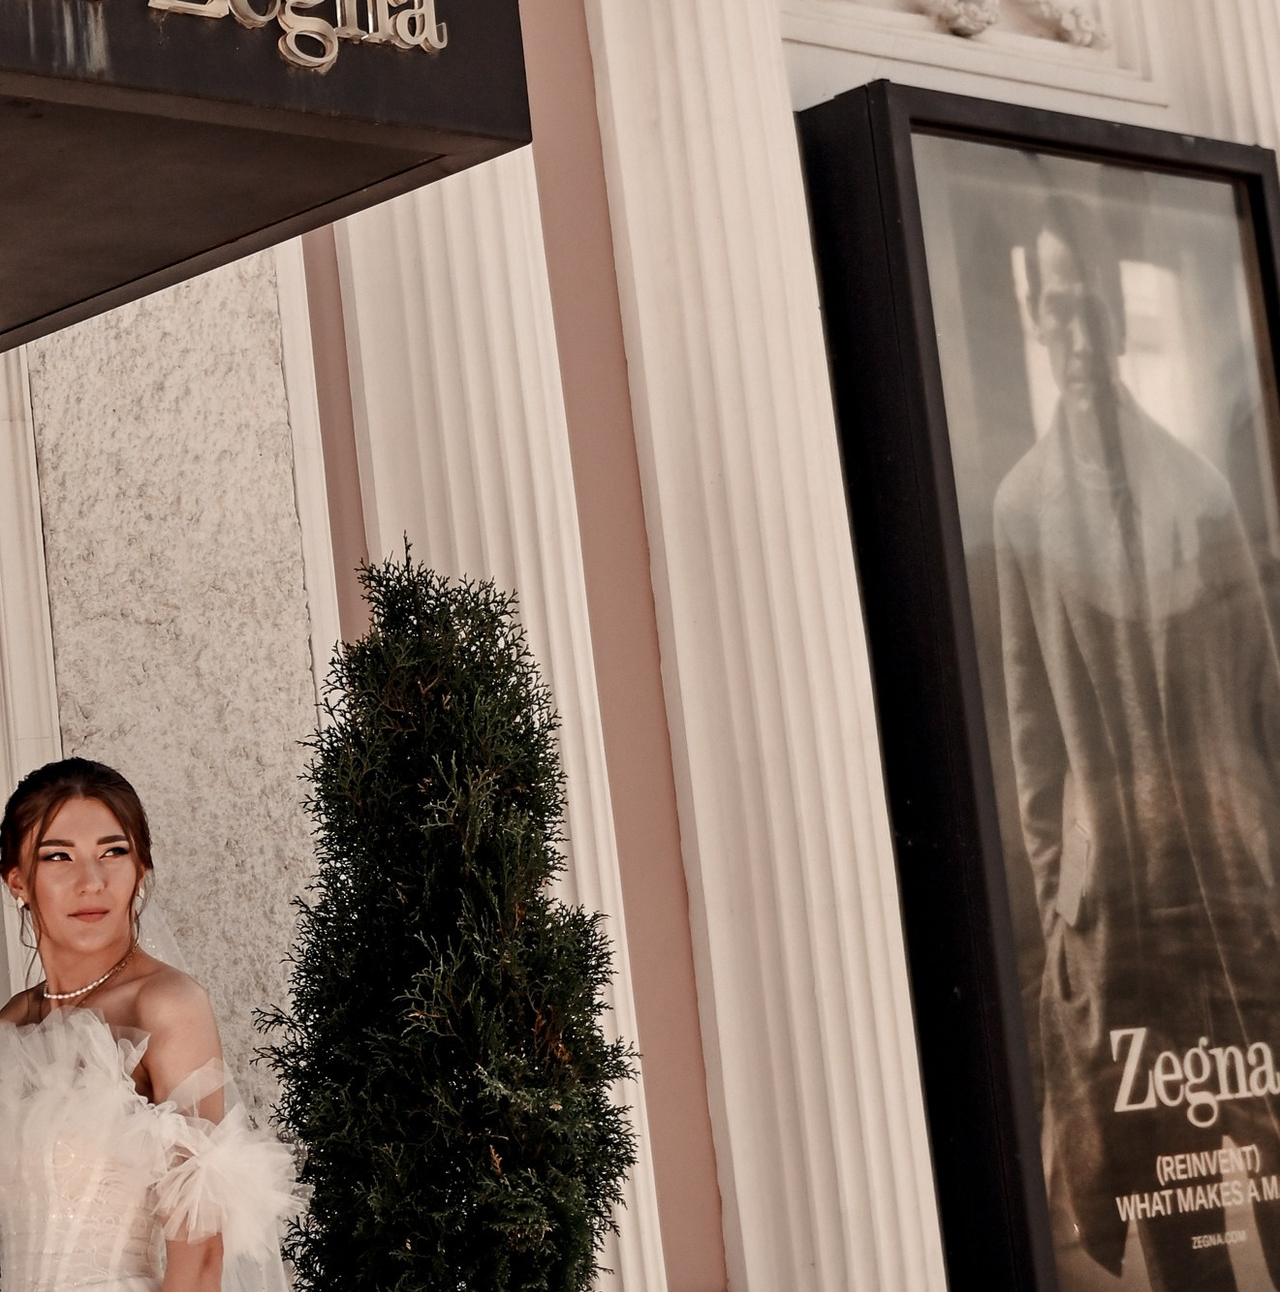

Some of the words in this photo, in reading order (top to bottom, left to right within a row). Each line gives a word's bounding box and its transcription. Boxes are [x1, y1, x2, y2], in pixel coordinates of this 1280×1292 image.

[1110, 1027, 1280, 1128] Zegna
[1156, 1144, 1261, 1186] (REINVENT)
[1116, 1190, 1173, 1222] WHAT
[1177, 1180, 1244, 1215] MAKES
[1248, 1178, 1261, 1203] A
[1261, 1175, 1280, 1201] M
